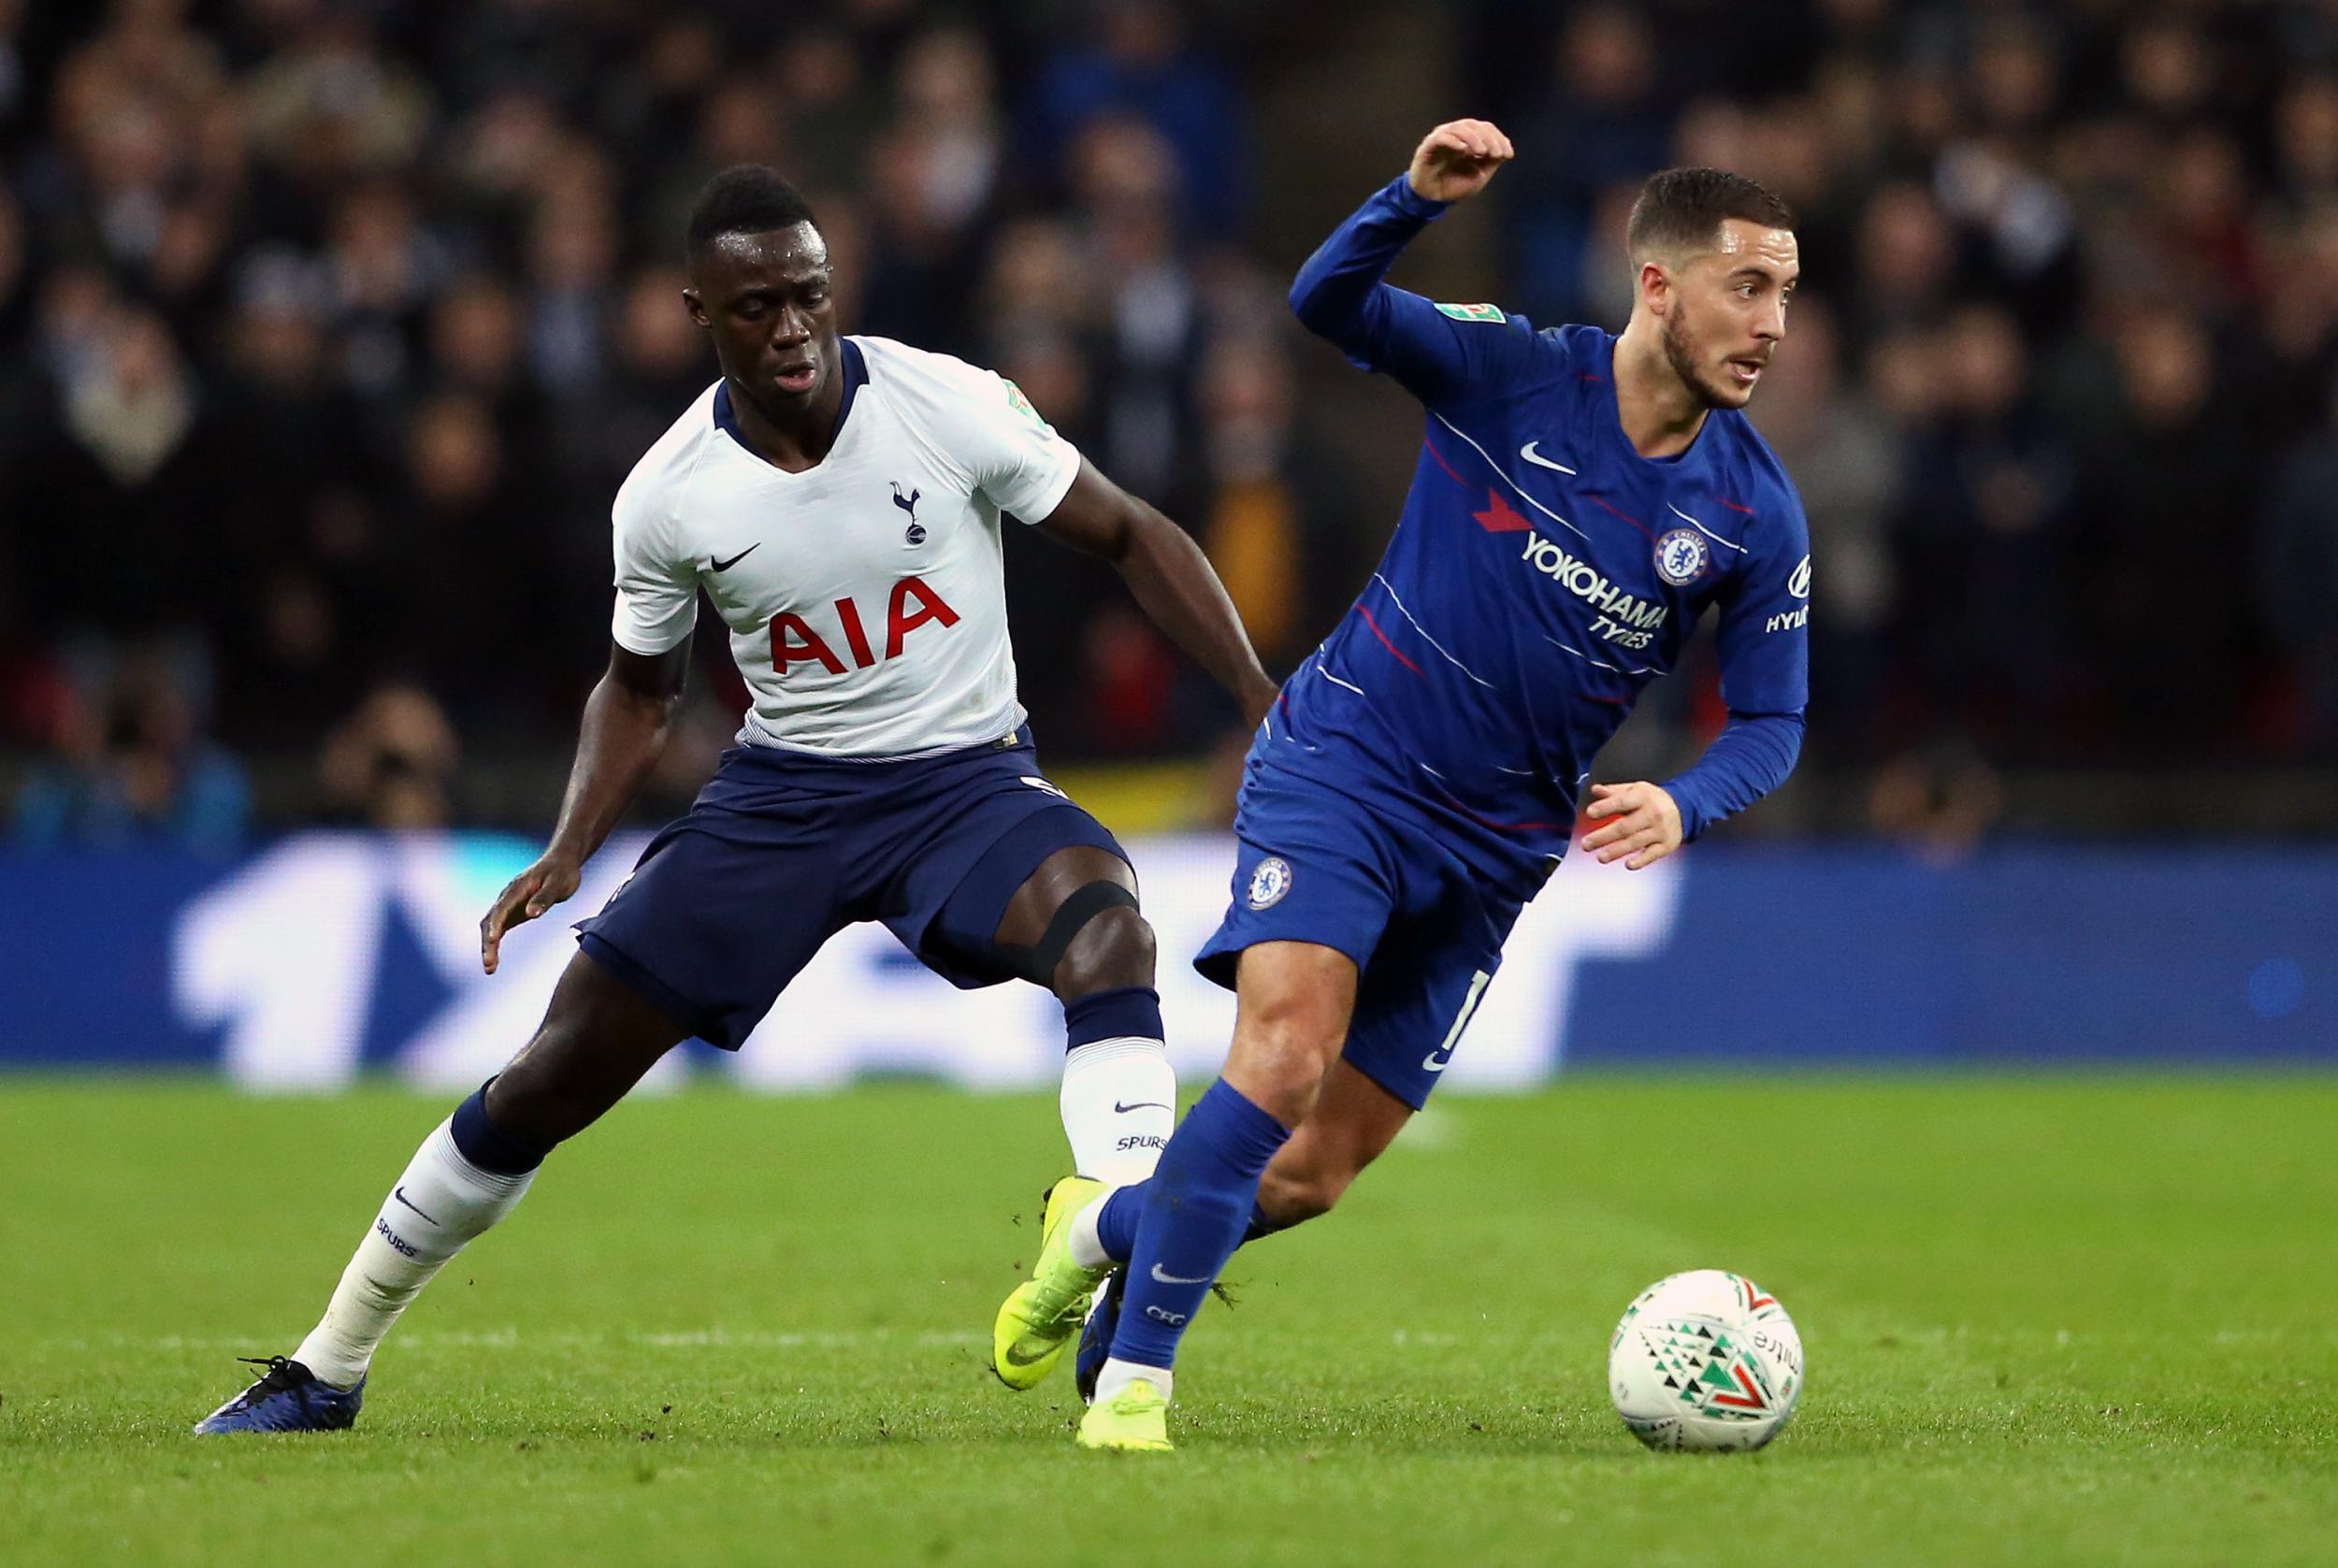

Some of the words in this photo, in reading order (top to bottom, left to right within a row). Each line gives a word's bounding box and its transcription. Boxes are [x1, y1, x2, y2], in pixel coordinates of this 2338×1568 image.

[1522, 530, 1668, 629] YOKOHAMA
[770, 576, 960, 674] AIA
[1589, 615, 1653, 649] TYRES
[1117, 1136, 1168, 1151] SPURS
[377, 1217, 417, 1257] SPURS
[1147, 1305, 1186, 1325] CFC
